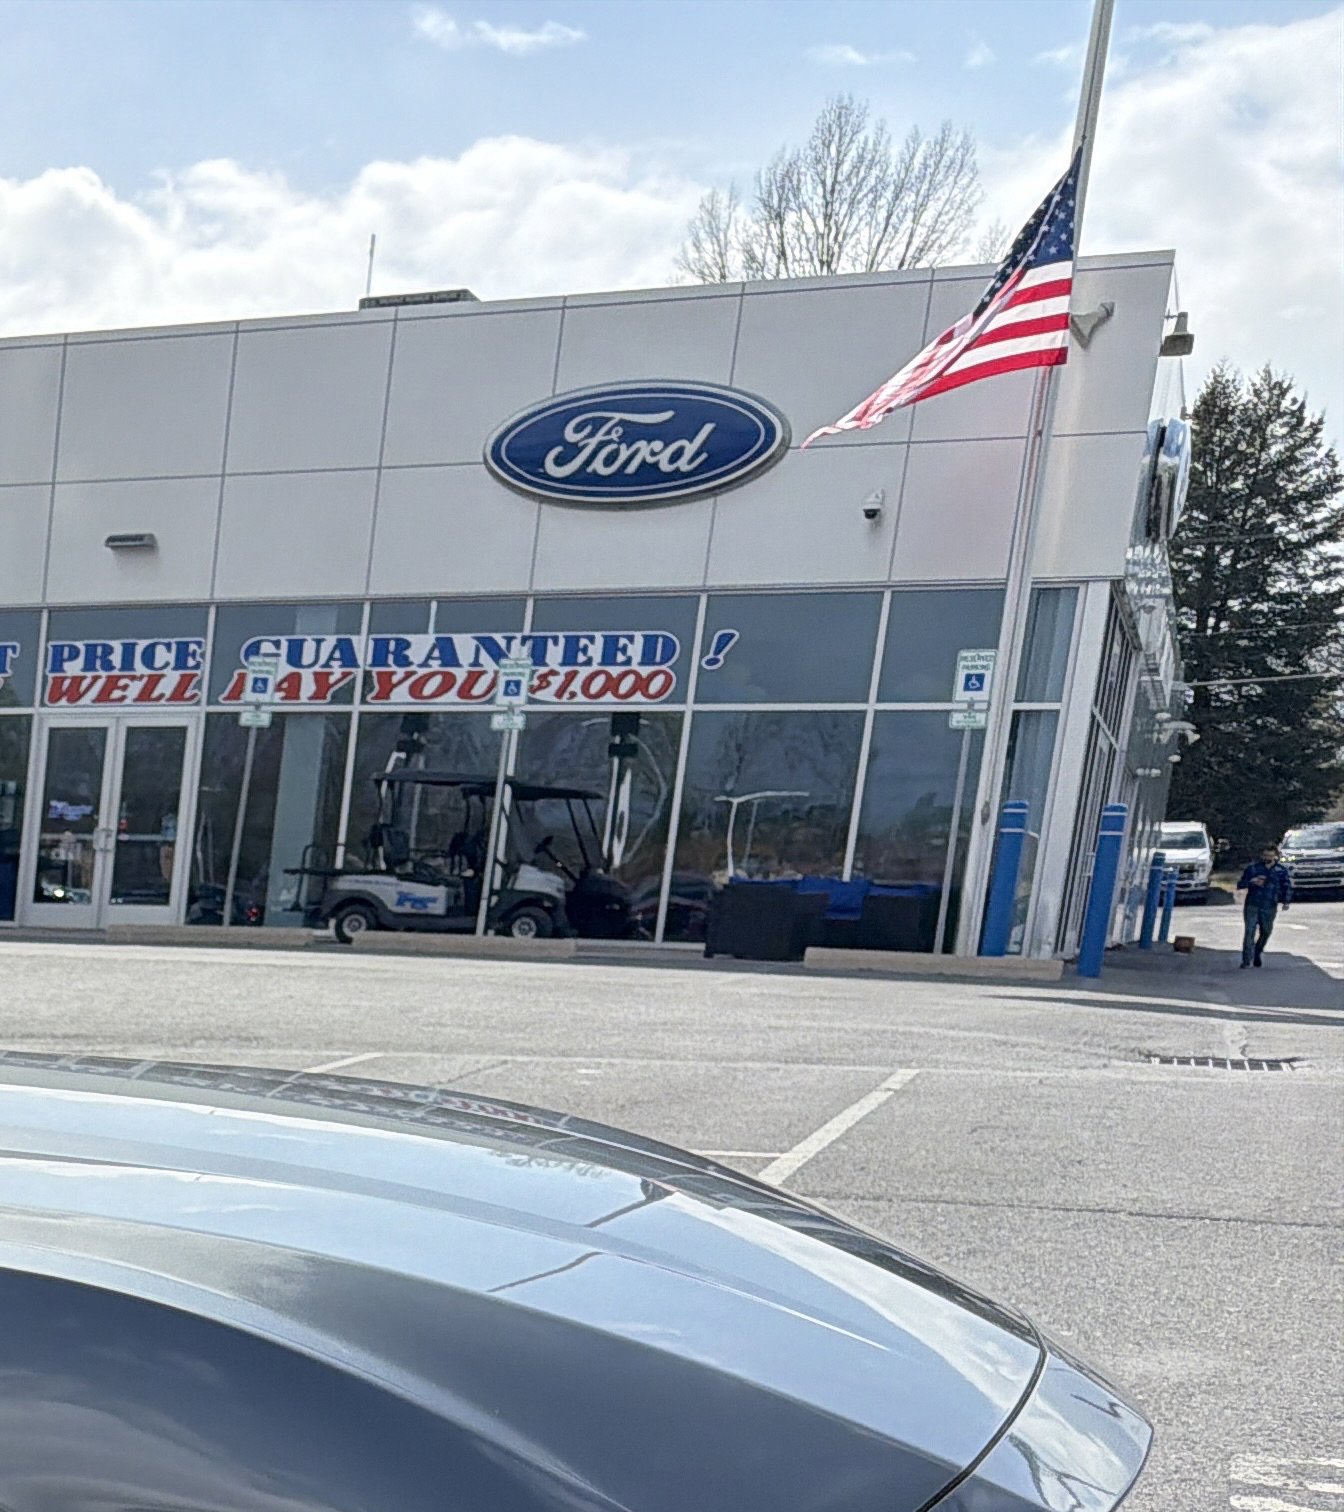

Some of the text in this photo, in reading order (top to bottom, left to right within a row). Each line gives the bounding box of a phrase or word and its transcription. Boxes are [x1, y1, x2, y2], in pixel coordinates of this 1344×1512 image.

[543, 410, 716, 478] Ford
[48, 640, 204, 673] PRICE
[243, 634, 678, 668] GUARANTEED
[372, 670, 498, 701] YOU
[528, 669, 674, 700] $1,000
